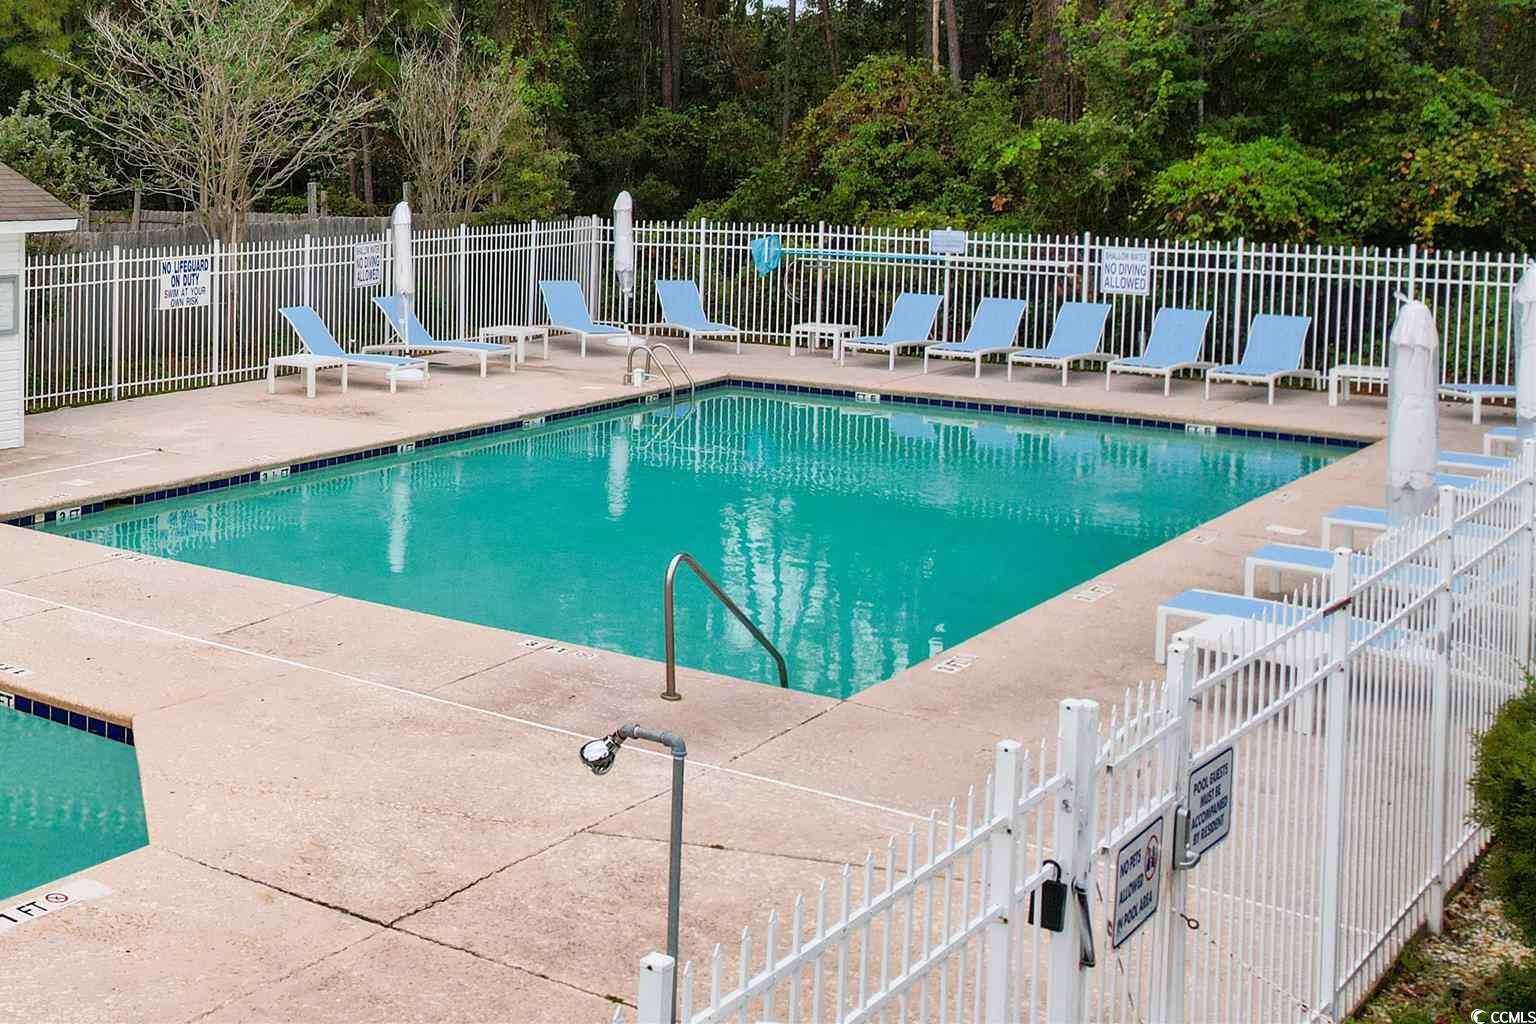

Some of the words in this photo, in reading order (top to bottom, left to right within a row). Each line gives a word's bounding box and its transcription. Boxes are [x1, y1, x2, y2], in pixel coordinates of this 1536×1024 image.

[162, 261, 172, 274] NO
[174, 259, 208, 273] LIFEGUARD
[1104, 262, 1117, 274] NO
[1119, 263, 1147, 276] DIVING
[171, 275, 180, 287] ON
[183, 273, 199, 286] DUTY
[1104, 276, 1146, 290] ALLOWED
[164, 289, 179, 299] SWIM
[181, 287, 190, 297] AT
[1193, 776, 1209, 796] POOL
[1120, 859, 1129, 877] NO
[1129, 848, 1142, 870] PETS
[1119, 872, 1144, 905] ALLOWED
[16, 901, 48, 917] FT
[1124, 904, 1138, 924] POOL
